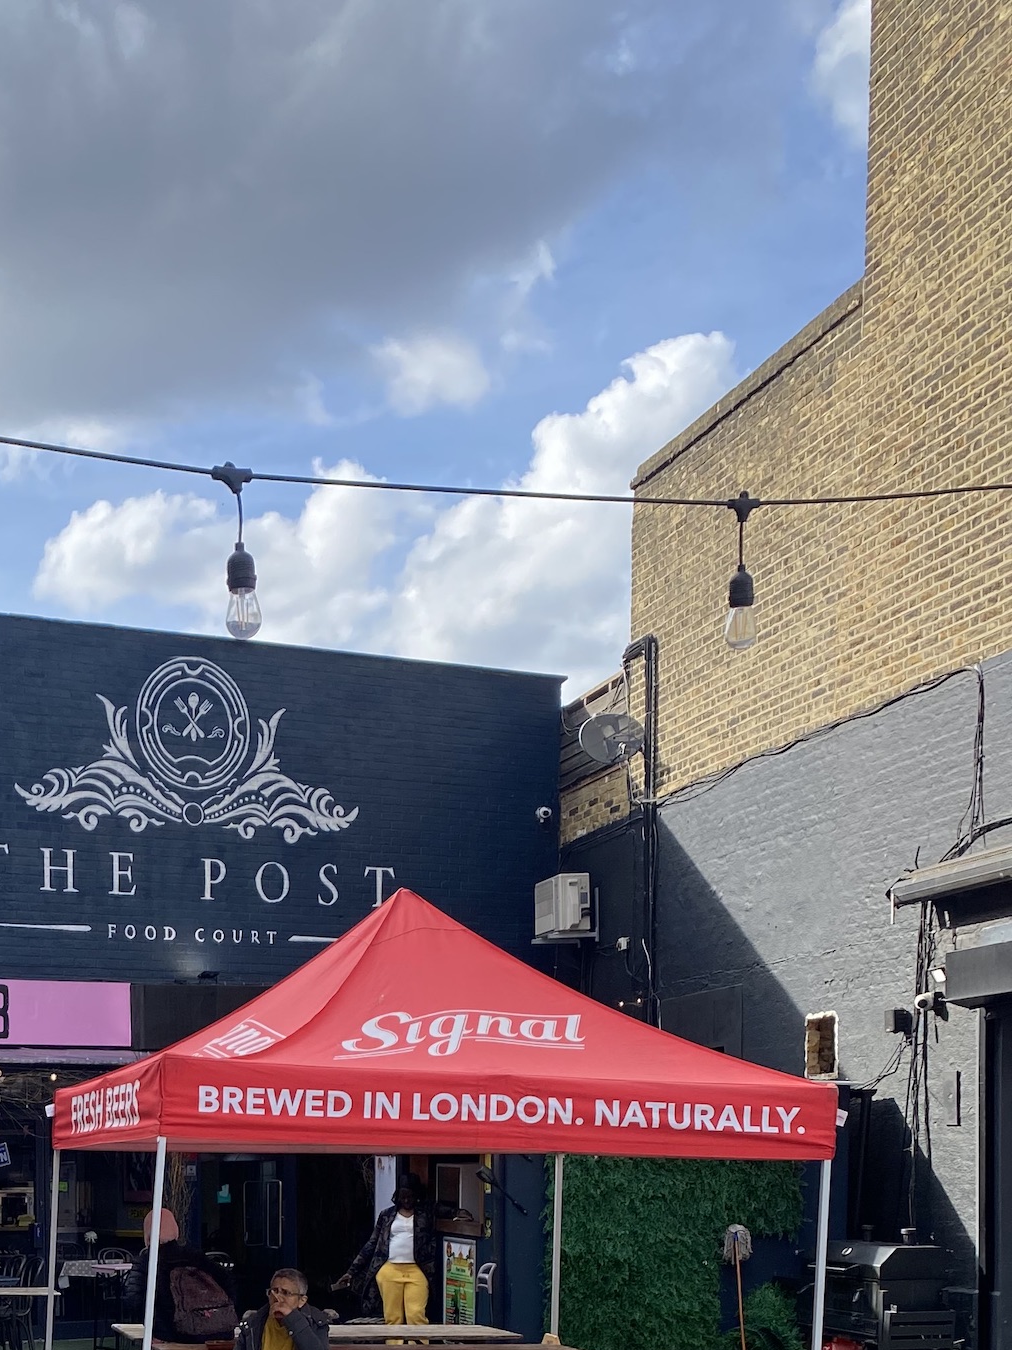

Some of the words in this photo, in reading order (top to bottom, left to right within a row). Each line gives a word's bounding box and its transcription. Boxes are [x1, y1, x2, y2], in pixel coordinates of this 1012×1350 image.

[200, 858, 395, 908] POST
[108, 923, 177, 941] FOOD
[194, 927, 277, 945] COURT
[341, 1008, 585, 1057] Signal
[71, 1088, 104, 1134] FRESH
[105, 1080, 141, 1128] BEERS
[198, 1085, 352, 1118] BREWED
[363, 1091, 400, 1119] IN
[413, 1092, 583, 1126] LONDON.
[595, 1098, 806, 1134] NATURALLY.
